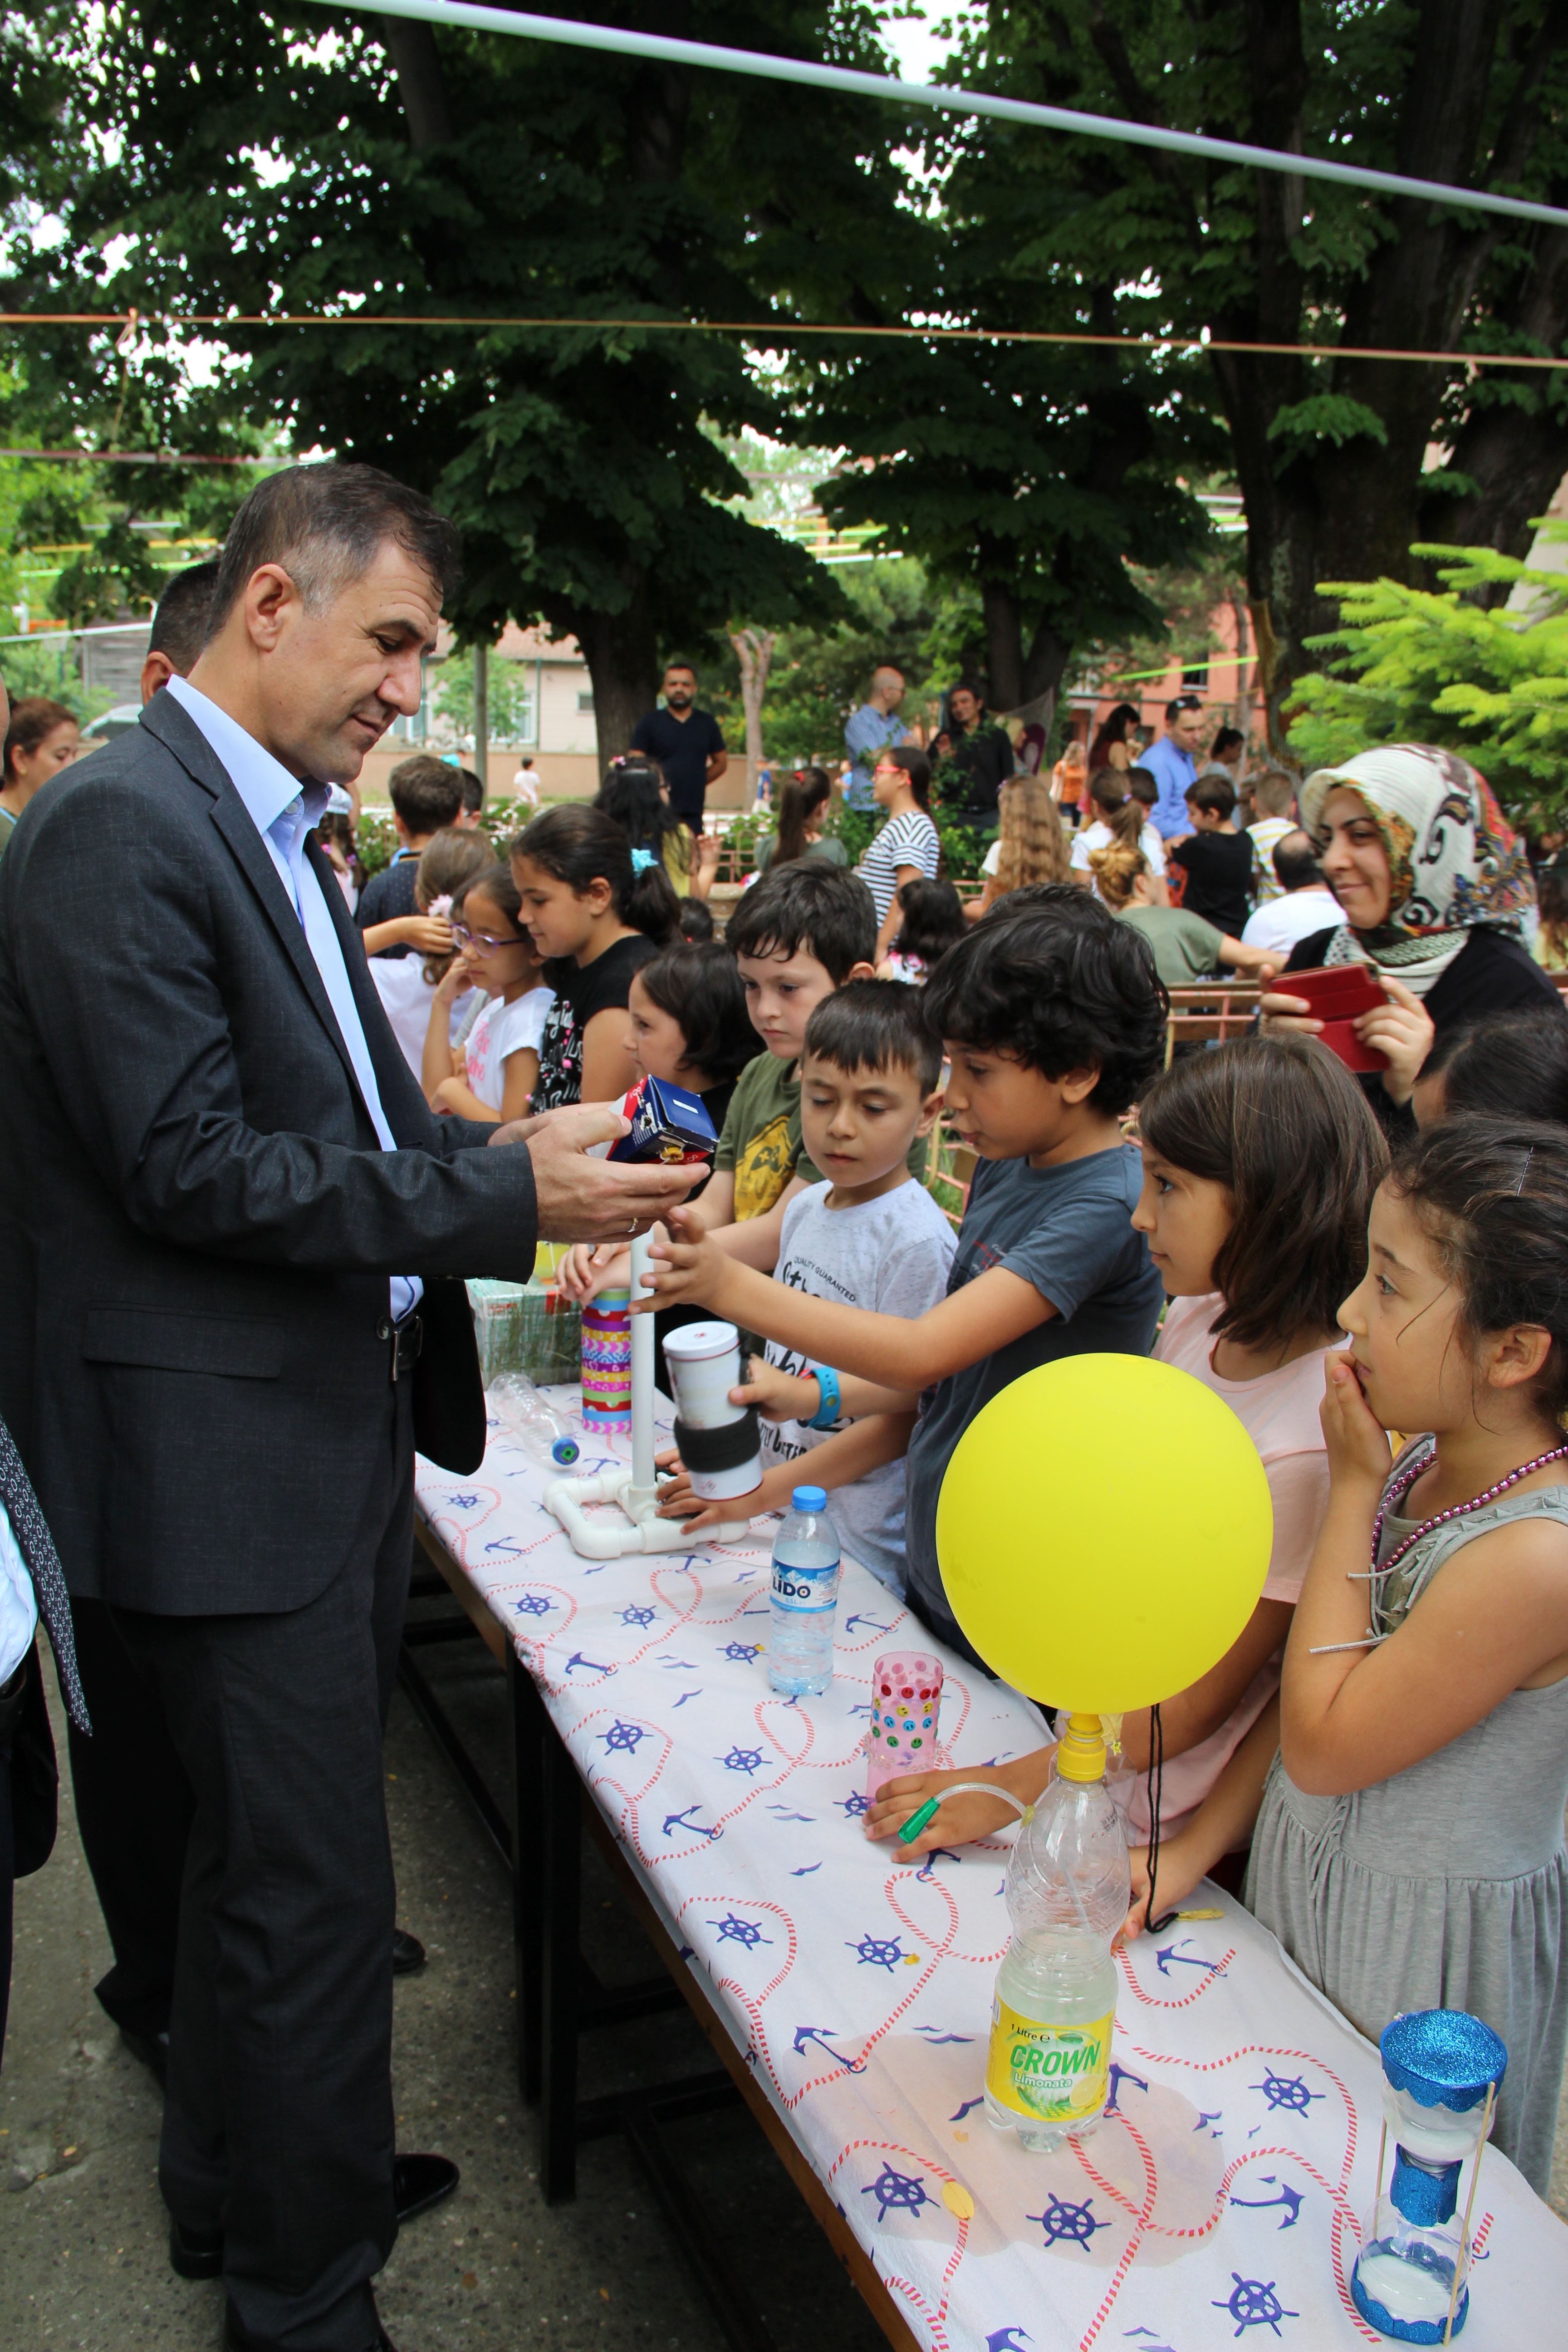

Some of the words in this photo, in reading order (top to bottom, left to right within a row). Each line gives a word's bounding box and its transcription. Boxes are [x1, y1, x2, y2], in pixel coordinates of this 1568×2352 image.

[794, 1256, 817, 1269] QUALITY
[815, 1267, 856, 1302] GUARANTED
[1017, 2026, 1038, 2041] Litre
[1010, 2040, 1101, 2076] CROWN
[1014, 2072, 1073, 2088] Limonata
